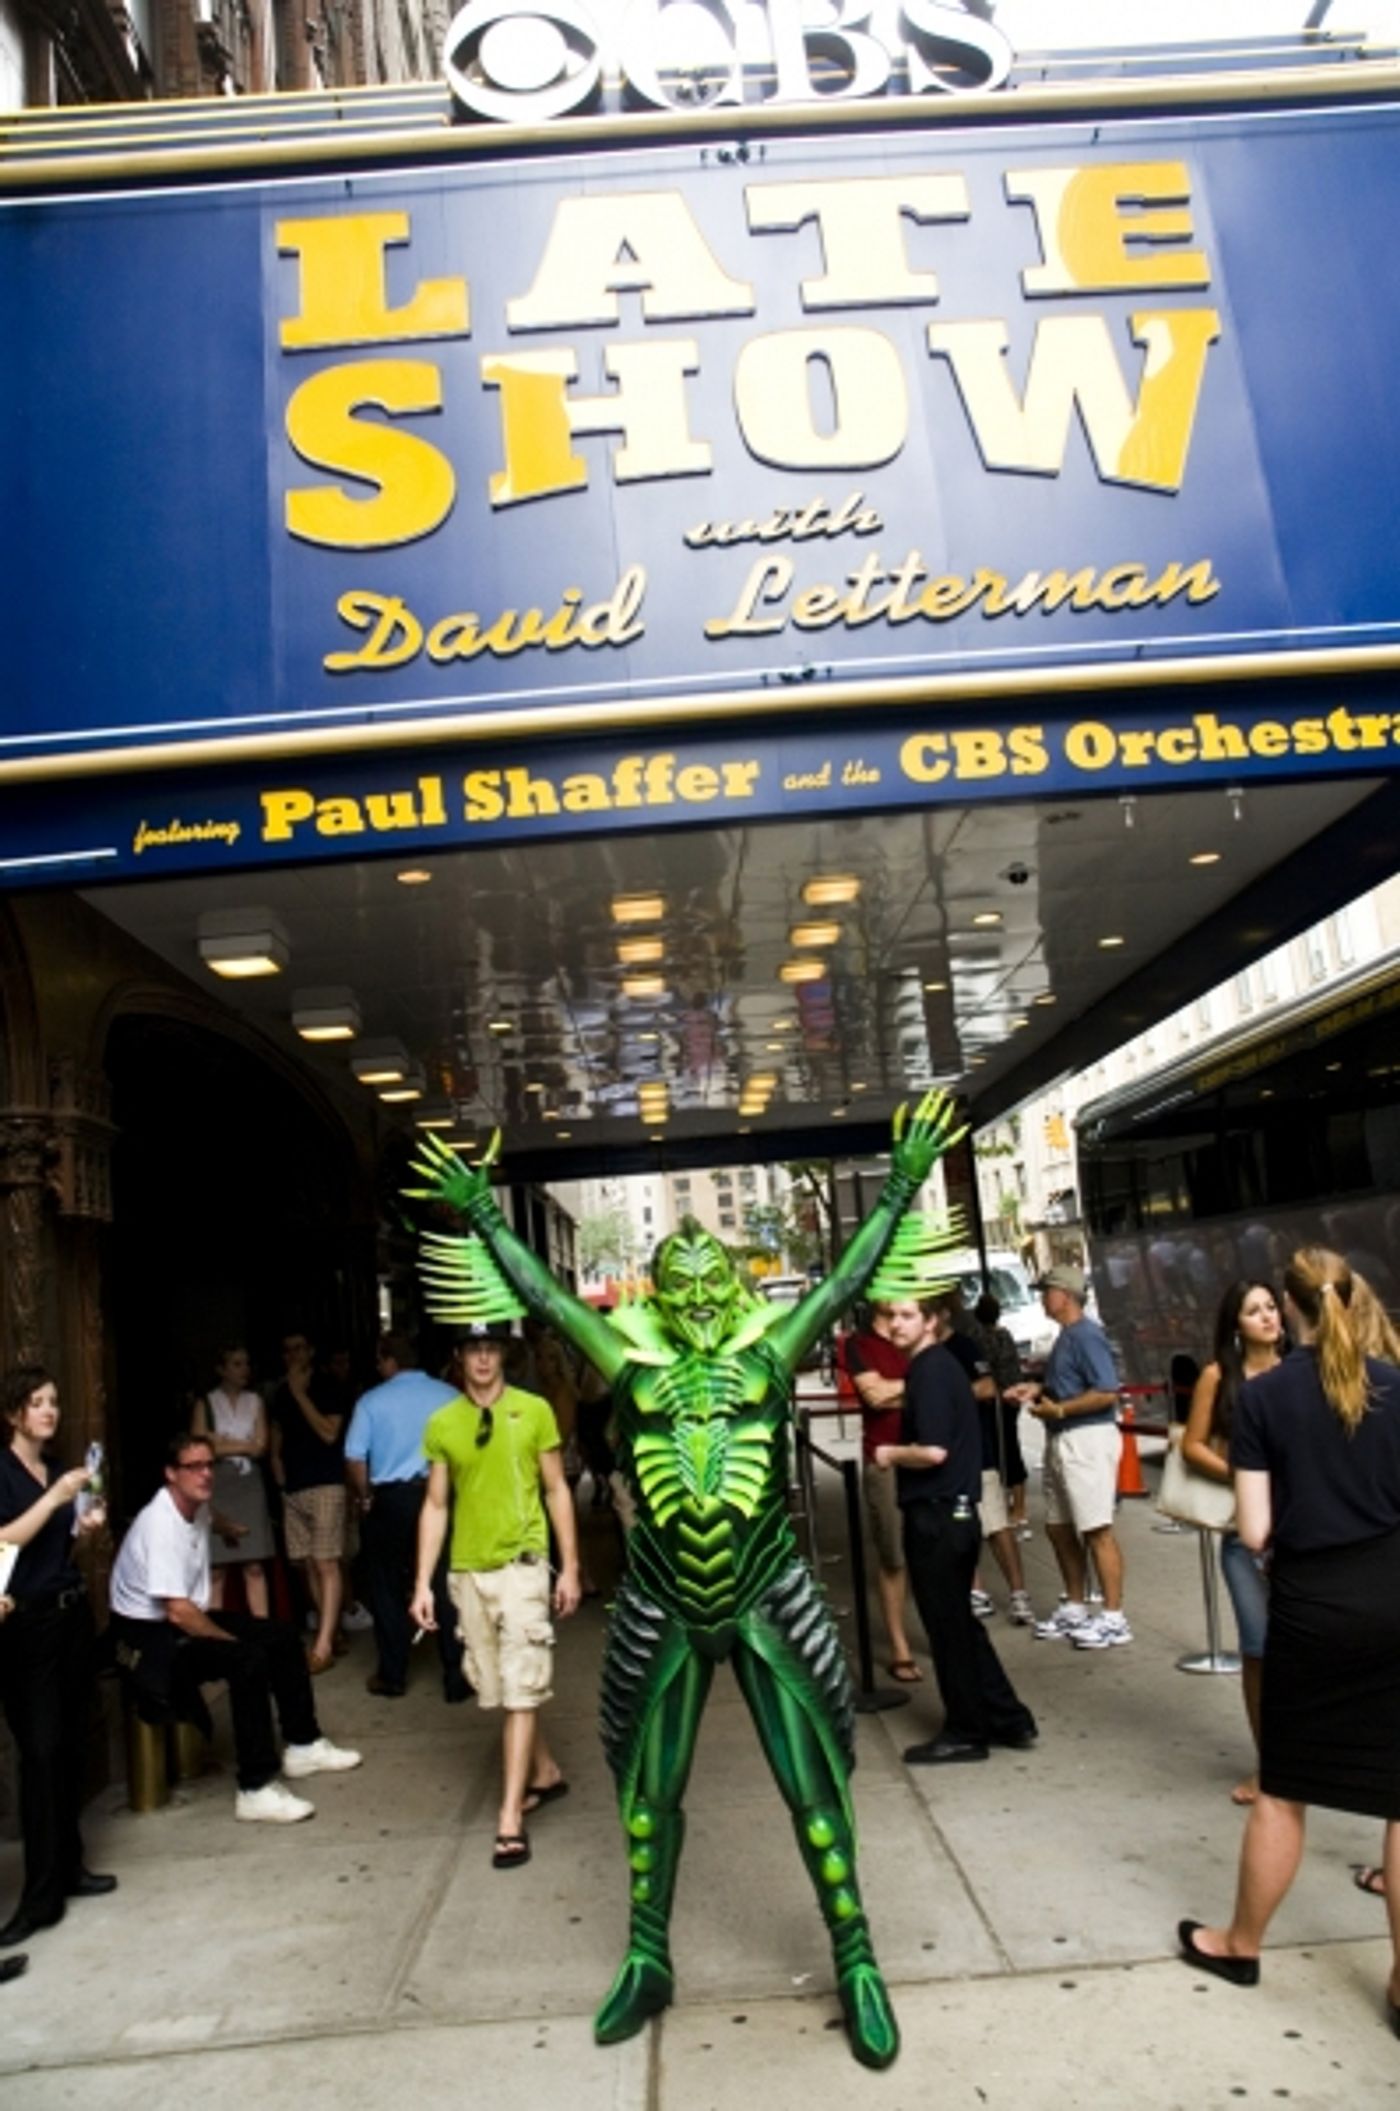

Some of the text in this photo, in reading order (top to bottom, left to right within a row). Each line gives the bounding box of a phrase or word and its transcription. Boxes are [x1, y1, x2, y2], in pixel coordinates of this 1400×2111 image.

[616, 0, 1013, 111] CBS
[275, 162, 1212, 351] LATE
[283, 308, 1222, 550] SHOW
[684, 492, 884, 547] with
[324, 550, 1219, 673] David Letterman
[133, 706, 1400, 853] featuring Paul Shaffer and the CBS Orchestr
